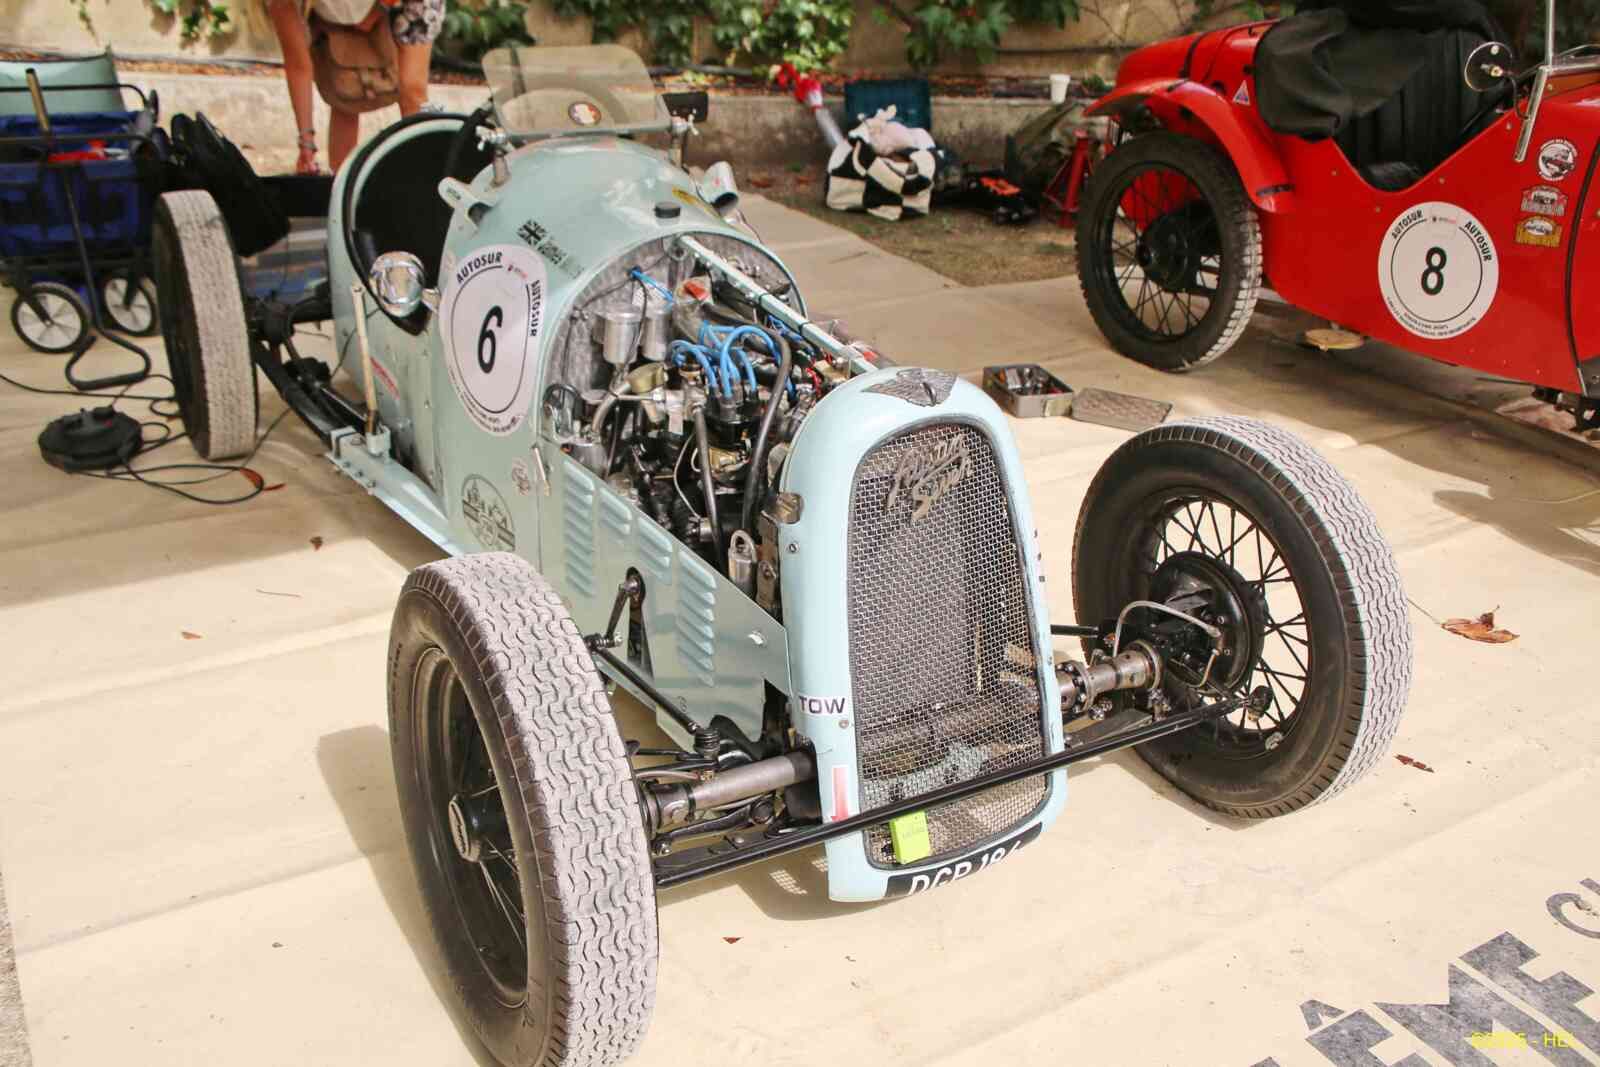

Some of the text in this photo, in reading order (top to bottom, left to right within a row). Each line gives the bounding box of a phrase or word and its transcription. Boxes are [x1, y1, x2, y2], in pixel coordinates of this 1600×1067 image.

[1391, 209, 1424, 240] AUTOSUR
[1464, 220, 1493, 262] AUTOSUR
[456, 251, 503, 284] AUTOSUR
[1420, 246, 1447, 296] 8
[528, 279, 543, 337] AUTOSUR
[477, 304, 503, 374] 6
[798, 696, 846, 714] TOW
